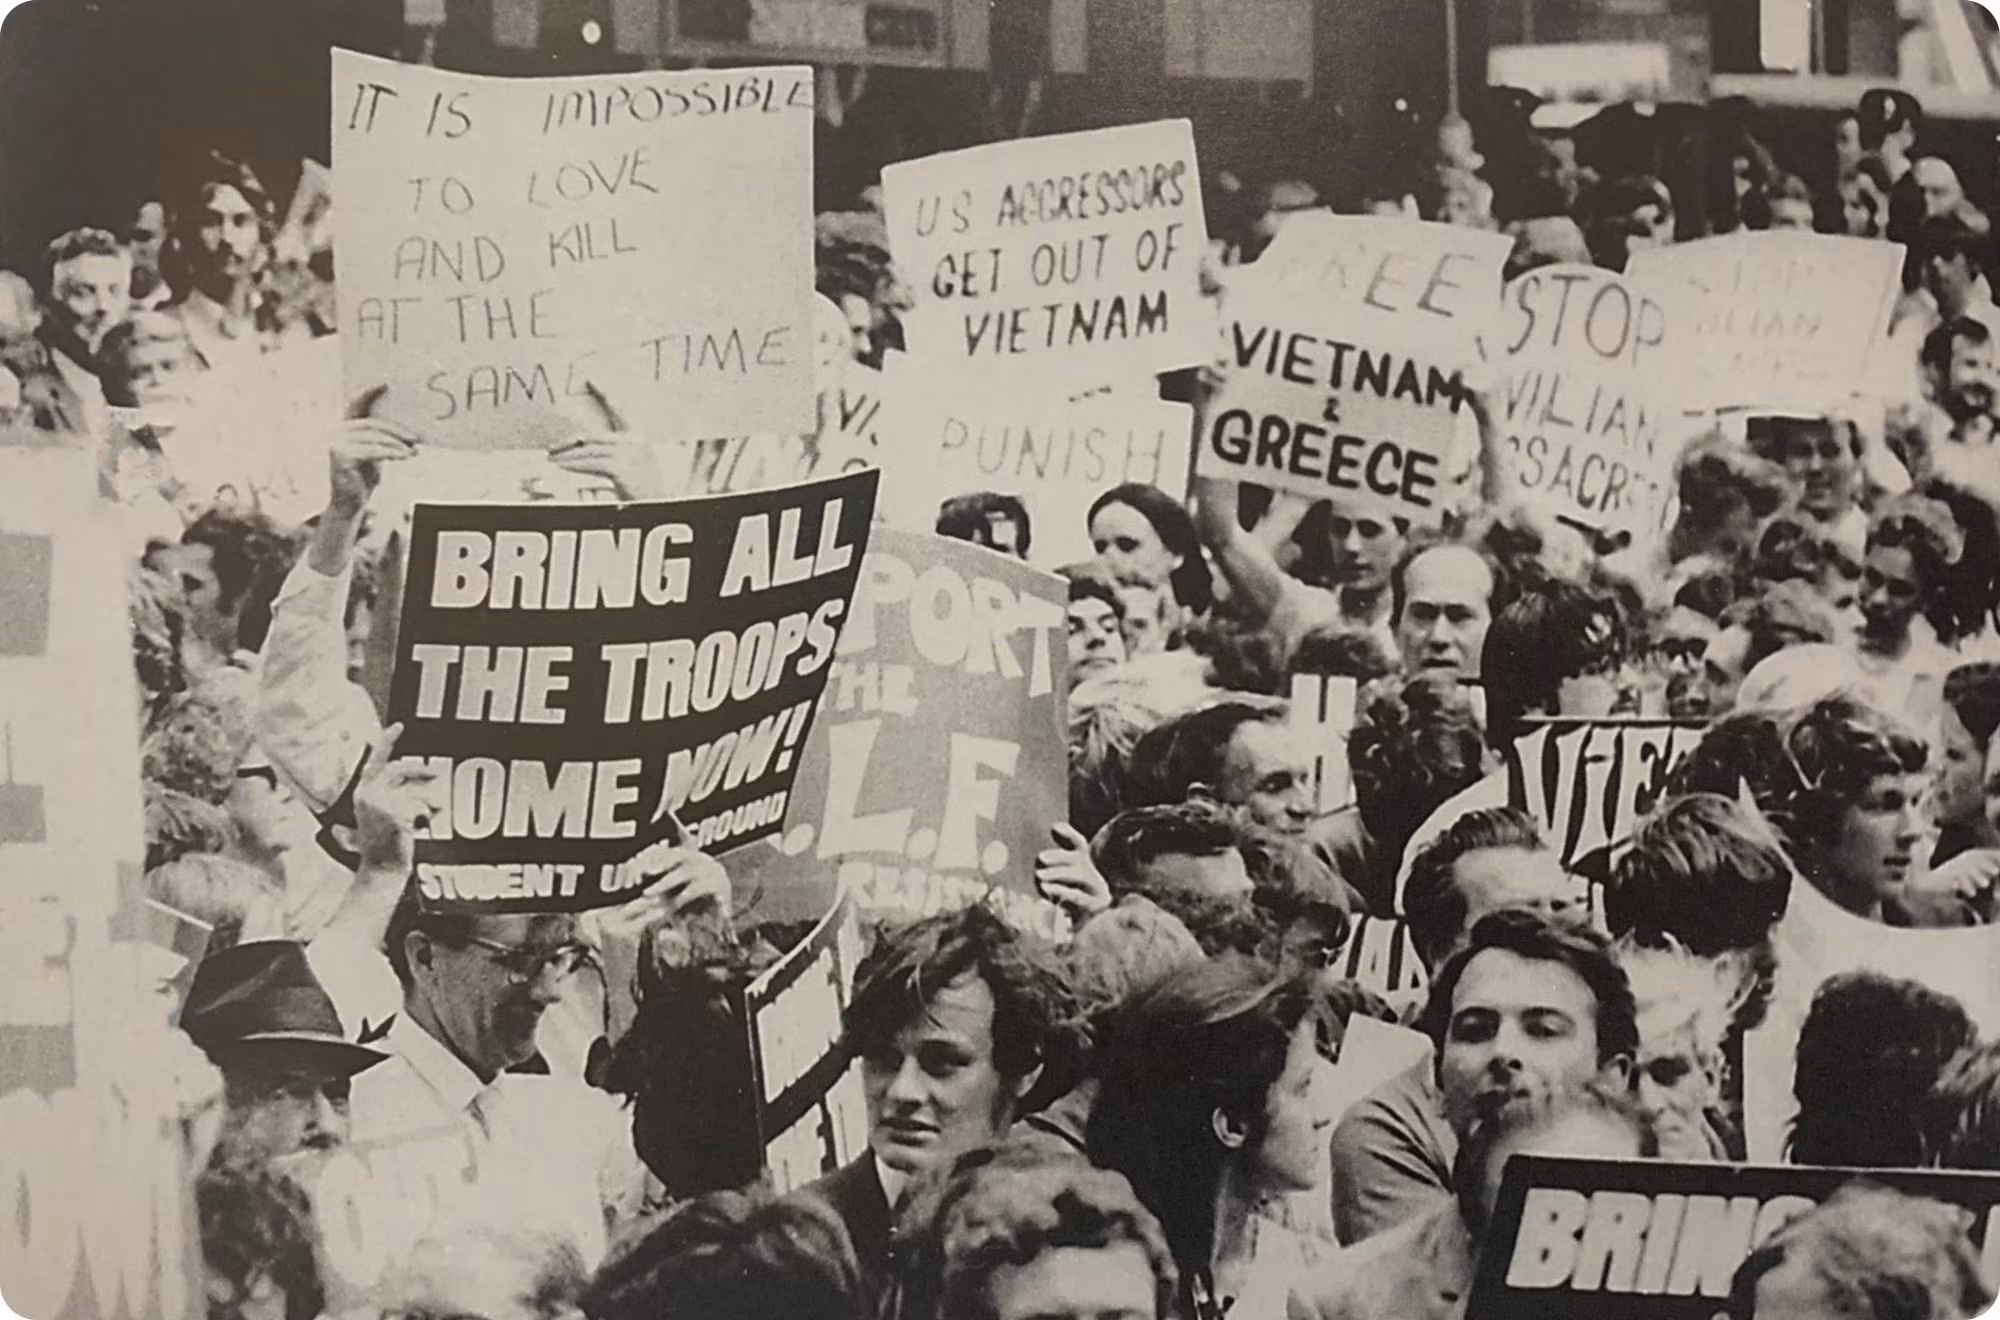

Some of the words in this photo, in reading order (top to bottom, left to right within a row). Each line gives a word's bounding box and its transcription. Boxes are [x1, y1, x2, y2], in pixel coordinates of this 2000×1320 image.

[348, 82, 398, 133] IT
[427, 91, 472, 138] IS
[543, 76, 814, 135] IMPOSSIBLE
[408, 177, 474, 214] TO
[527, 147, 659, 207] LOVE
[997, 159, 1186, 227] AGGRESSORS
[393, 236, 505, 282] AND
[550, 218, 638, 268] KILL
[932, 248, 1003, 299] GET
[1031, 234, 1111, 286] OUT
[1135, 223, 1184, 272] OF
[357, 297, 422, 343] AT
[446, 289, 558, 343] THE
[965, 290, 1168, 356] VIETNAM
[1507, 273, 1664, 366] STOP
[428, 352, 597, 420] SAME
[641, 326, 790, 381] TIME
[1232, 320, 1463, 414] VIETNAM
[1323, 397, 1341, 423] &
[942, 417, 1164, 484] PUNISH
[1211, 409, 1439, 508] GREECE
[1507, 436, 1657, 512] SACR
[430, 523, 694, 611] BRING
[719, 497, 854, 598] ALL
[412, 643, 573, 725] THE
[601, 598, 845, 724] TROOPS
[827, 661, 920, 718] HE
[399, 755, 642, 840] HOME
[417, 863, 585, 900] STUDENT
